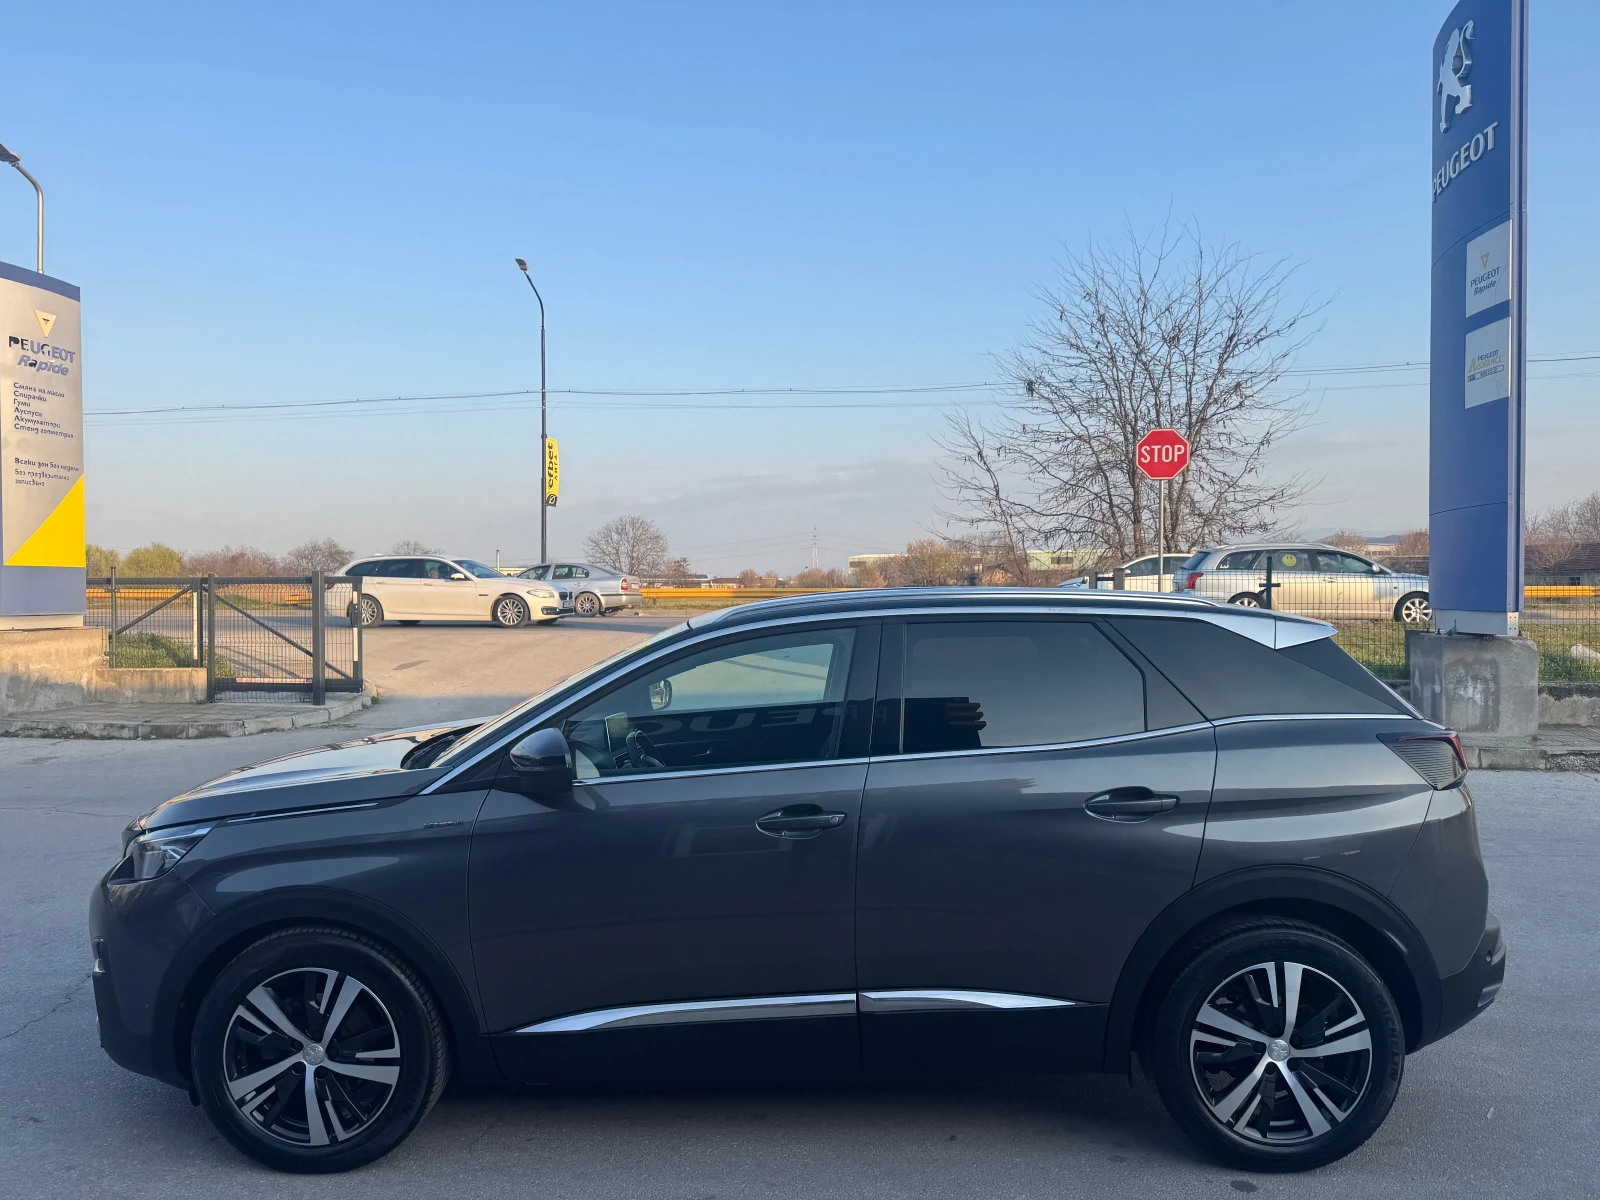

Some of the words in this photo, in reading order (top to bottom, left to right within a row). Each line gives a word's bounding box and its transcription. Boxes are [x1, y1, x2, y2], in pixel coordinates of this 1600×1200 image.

[1432, 121, 1499, 203] PEUGEOT
[1470, 266, 1501, 288] PEUGEOT
[1473, 279, 1497, 296] Rapide
[8, 335, 76, 363] PEUGEOT
[1477, 349, 1500, 362] PEUGEOT
[17, 354, 70, 376] Rapide
[13, 398, 31, 407] Гуми
[1140, 444, 1185, 463] STOP
